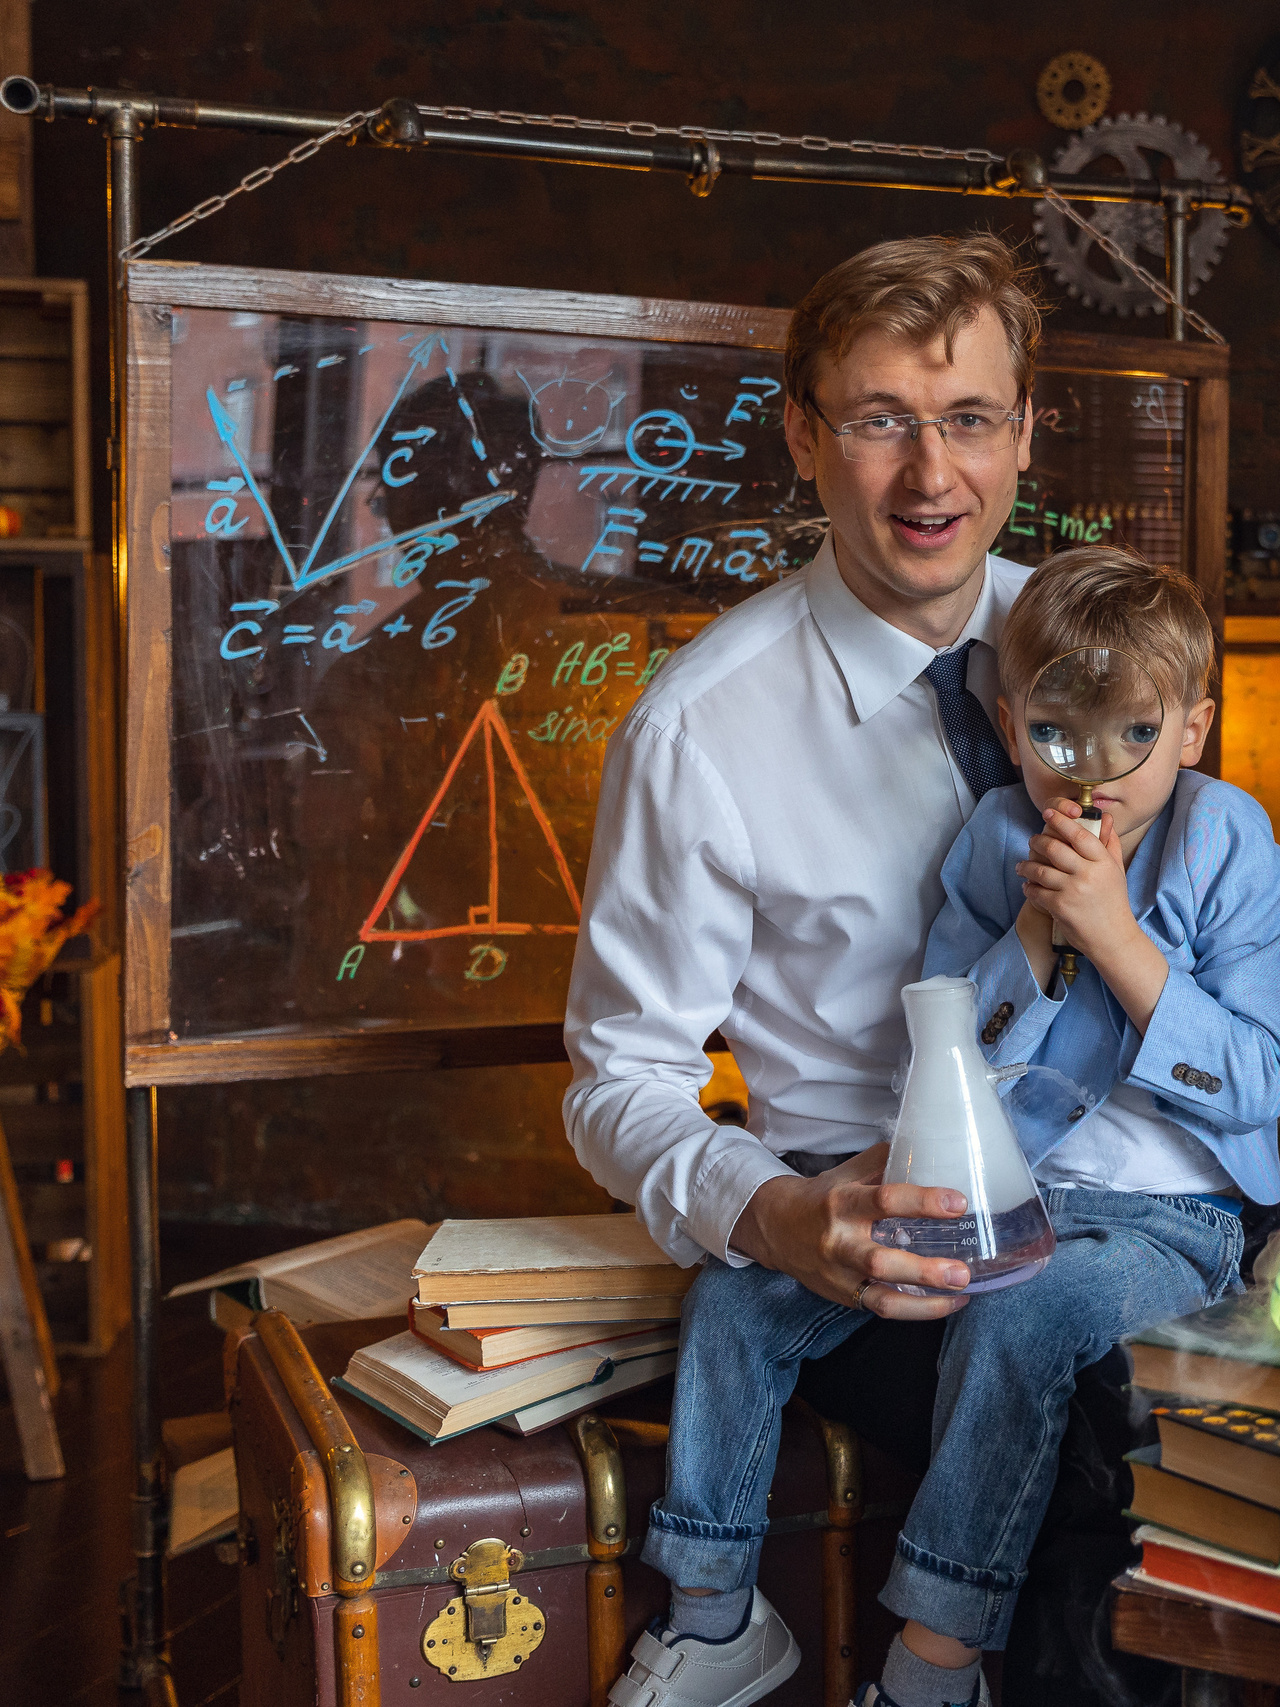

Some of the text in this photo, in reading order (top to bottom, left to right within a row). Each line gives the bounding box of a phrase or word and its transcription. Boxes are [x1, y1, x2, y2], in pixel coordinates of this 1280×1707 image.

[204, 497, 250, 535] a
[497, 653, 530, 695] B
[336, 945, 366, 982] A
[465, 946, 507, 982] D
[958, 1220, 976, 1231] 500
[960, 1237, 978, 1246] 400
